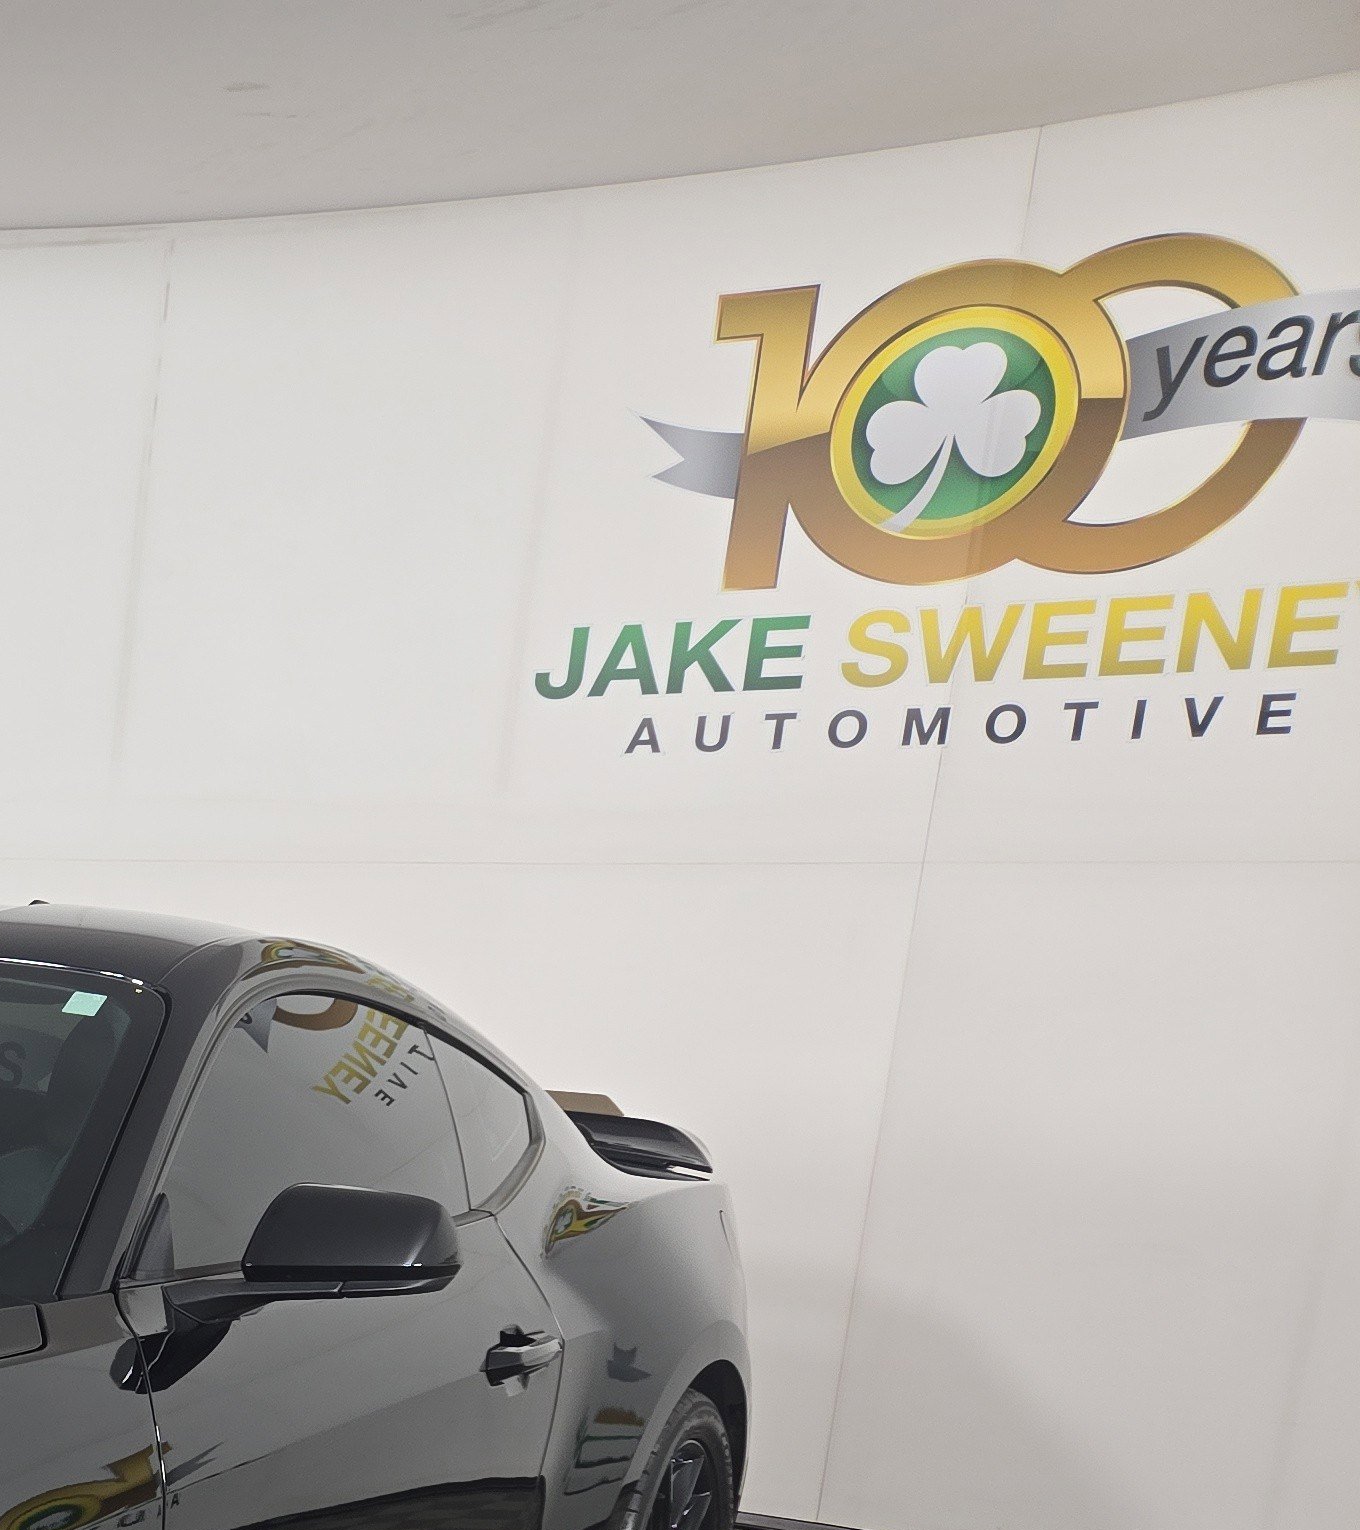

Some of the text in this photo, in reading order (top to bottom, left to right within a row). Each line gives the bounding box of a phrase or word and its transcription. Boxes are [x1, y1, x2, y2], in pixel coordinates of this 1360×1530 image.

[1142, 310, 1360, 422] year
[534, 580, 1360, 701] JAKE SWEENE
[624, 692, 1298, 755] AUTOMOTIVE
